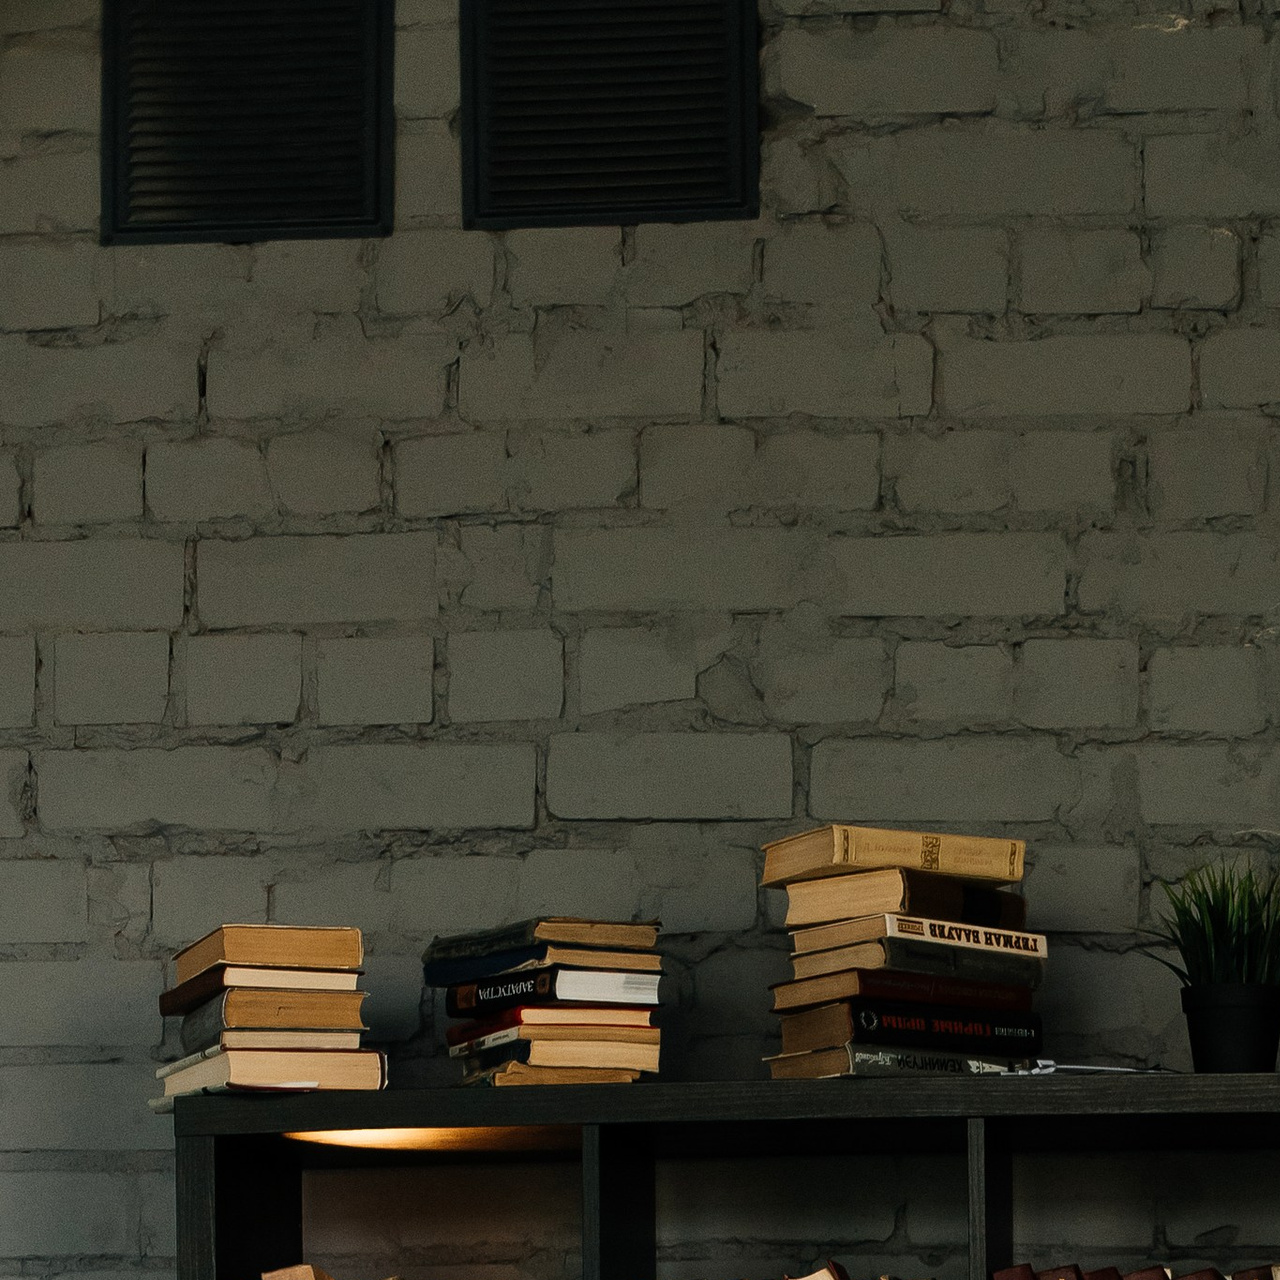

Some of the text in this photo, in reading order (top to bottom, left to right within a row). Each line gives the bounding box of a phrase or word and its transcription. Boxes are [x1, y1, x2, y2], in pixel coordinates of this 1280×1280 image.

[928, 923, 982, 946] БАЛУЕВ
[982, 930, 1039, 952] ГЕРМАН
[478, 979, 535, 1001] ЗАРАТУСТРА
[882, 1014, 992, 1038] ГОРНЫЕ ОРЛЫ
[897, 1054, 964, 1076] ХЕМИНГУЭЙ
